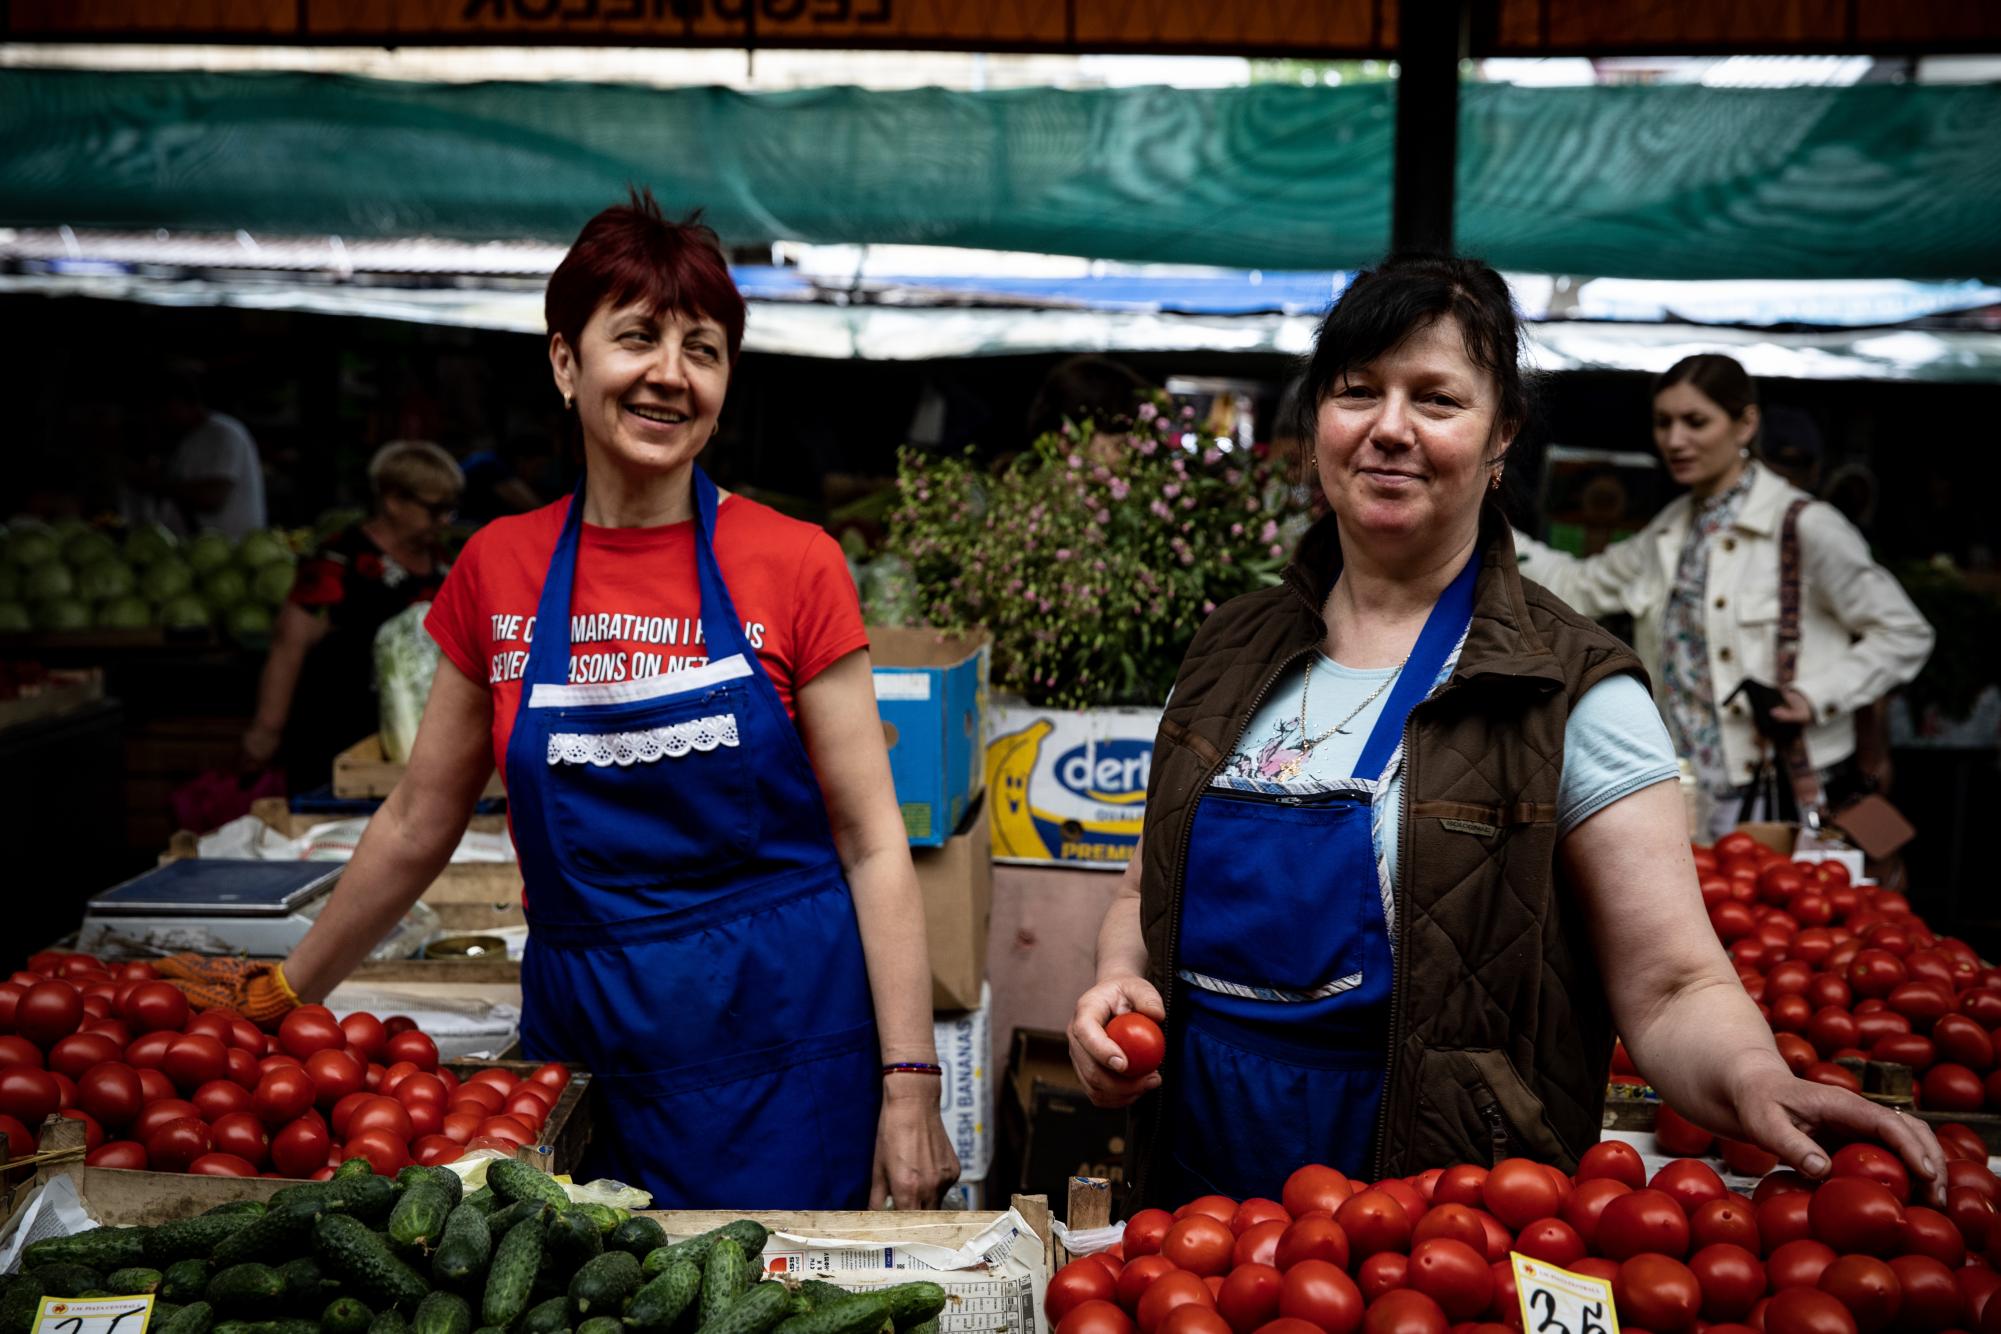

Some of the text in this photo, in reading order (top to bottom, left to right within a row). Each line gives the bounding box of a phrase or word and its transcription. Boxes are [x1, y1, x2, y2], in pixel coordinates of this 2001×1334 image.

[490, 613, 524, 642] THE
[570, 612, 678, 645] MARATHON
[682, 617, 691, 645] I
[568, 650, 628, 683] ASONS
[631, 651, 663, 681] ON
[956, 1019, 974, 1171] FRESH BANANAS
